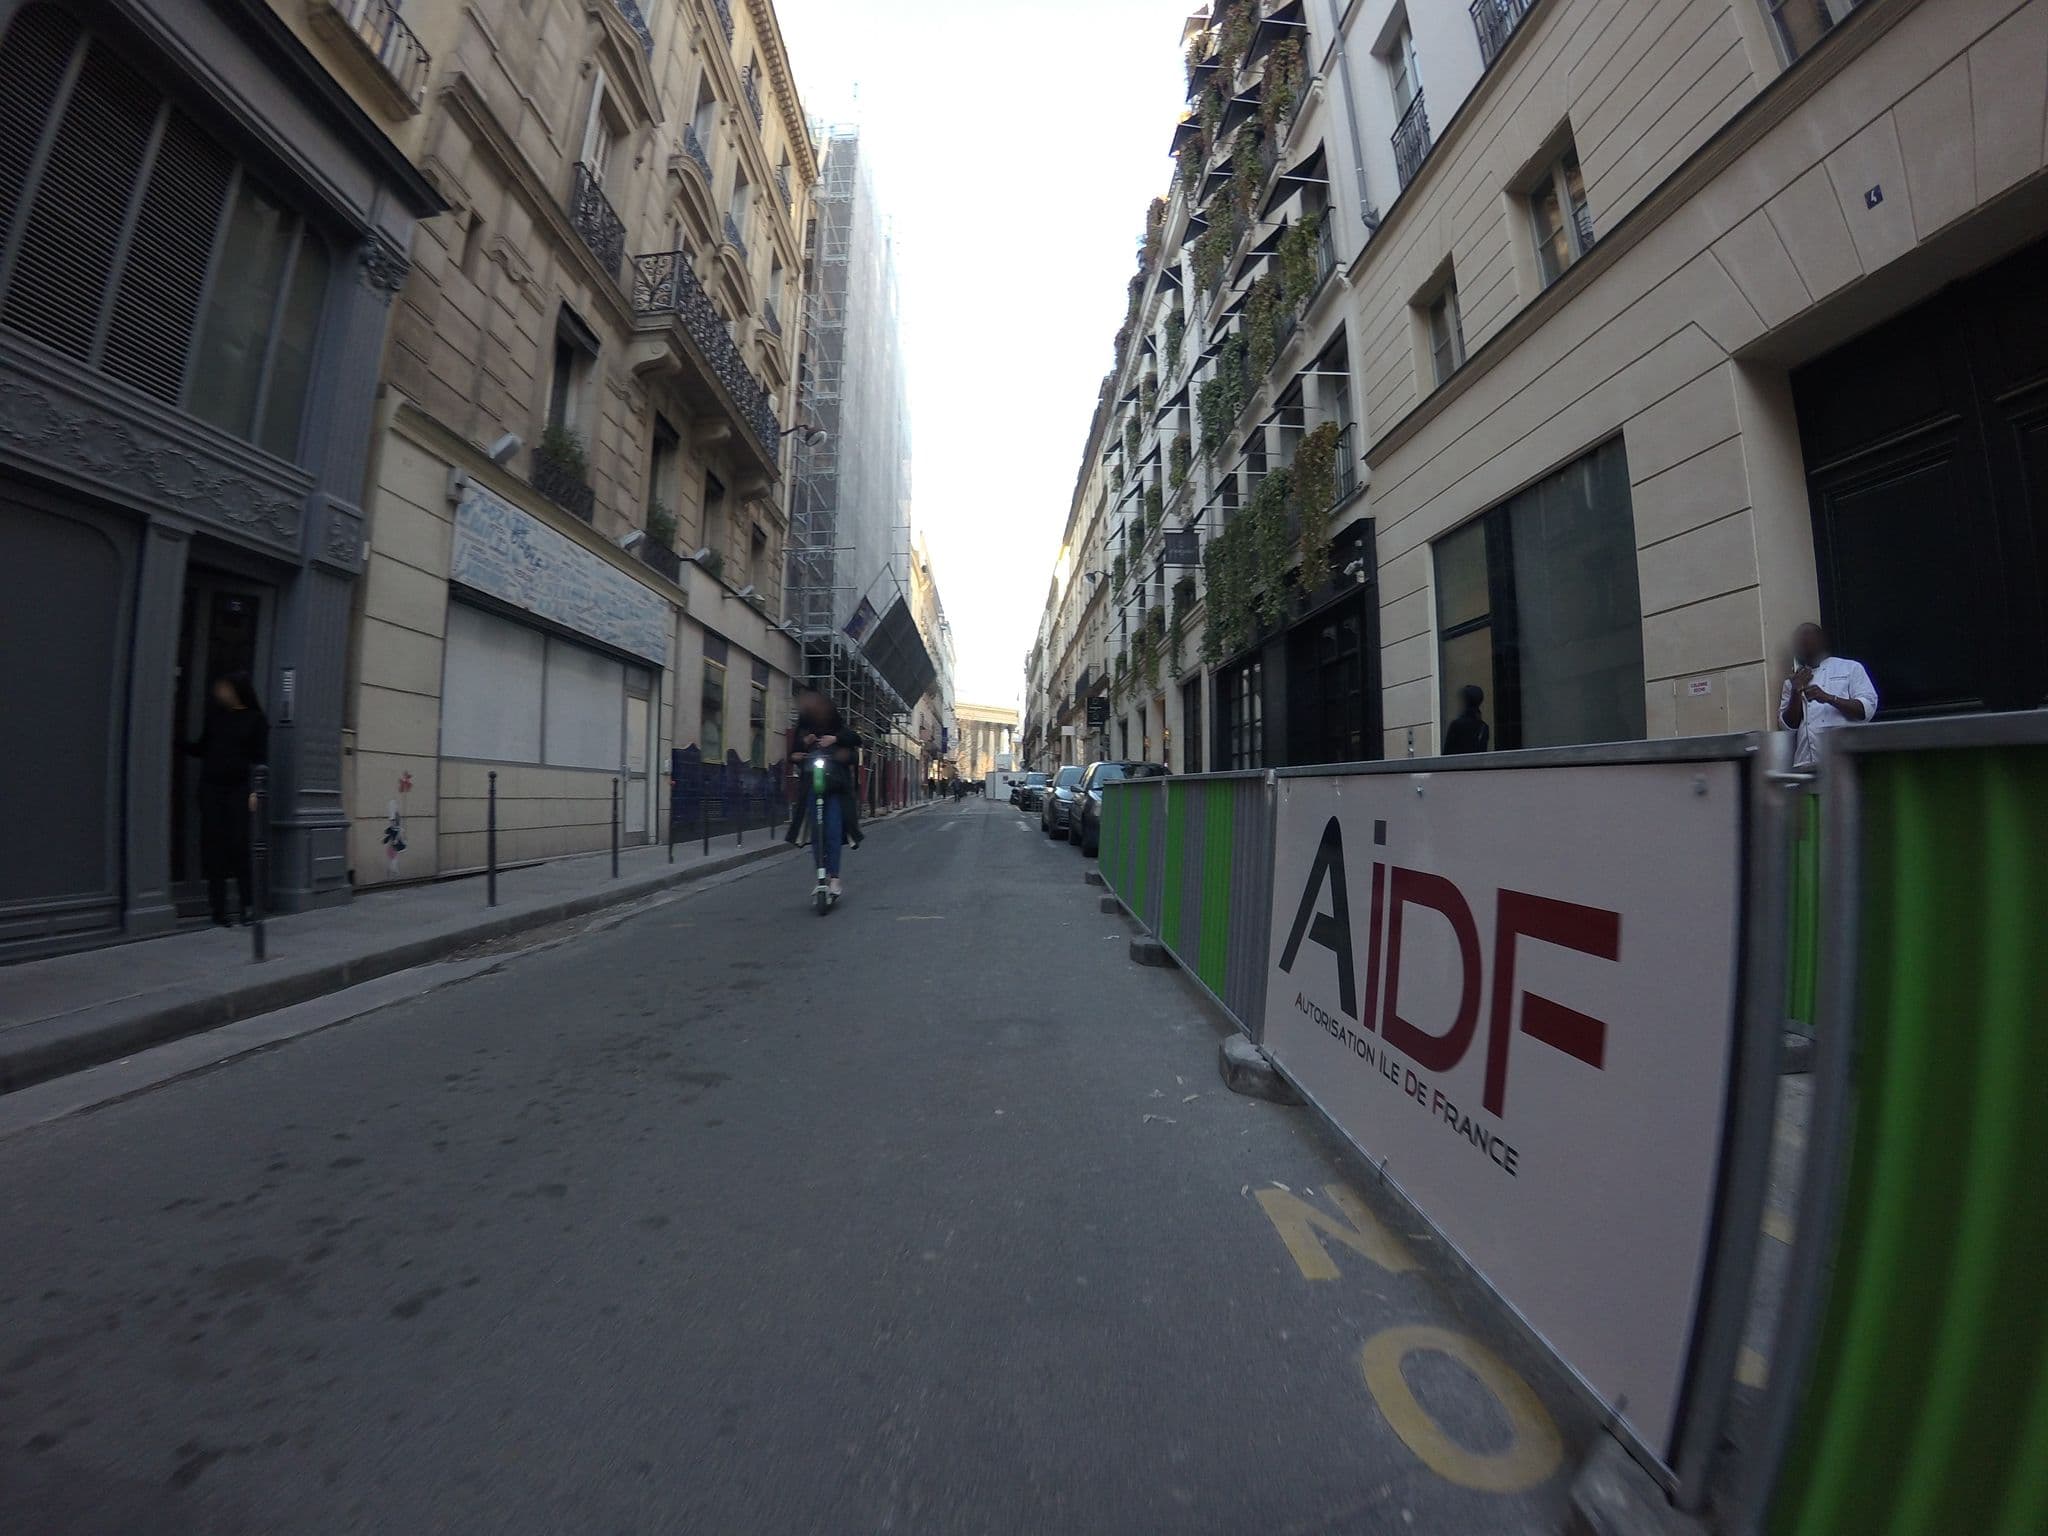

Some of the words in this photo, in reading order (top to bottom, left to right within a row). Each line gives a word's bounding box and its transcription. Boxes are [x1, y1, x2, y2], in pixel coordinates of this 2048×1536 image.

[1295, 991, 1376, 1066] AUTORISATION
[1404, 1069, 1428, 1106] DE
[1432, 1088, 1520, 1178] FRANCE
